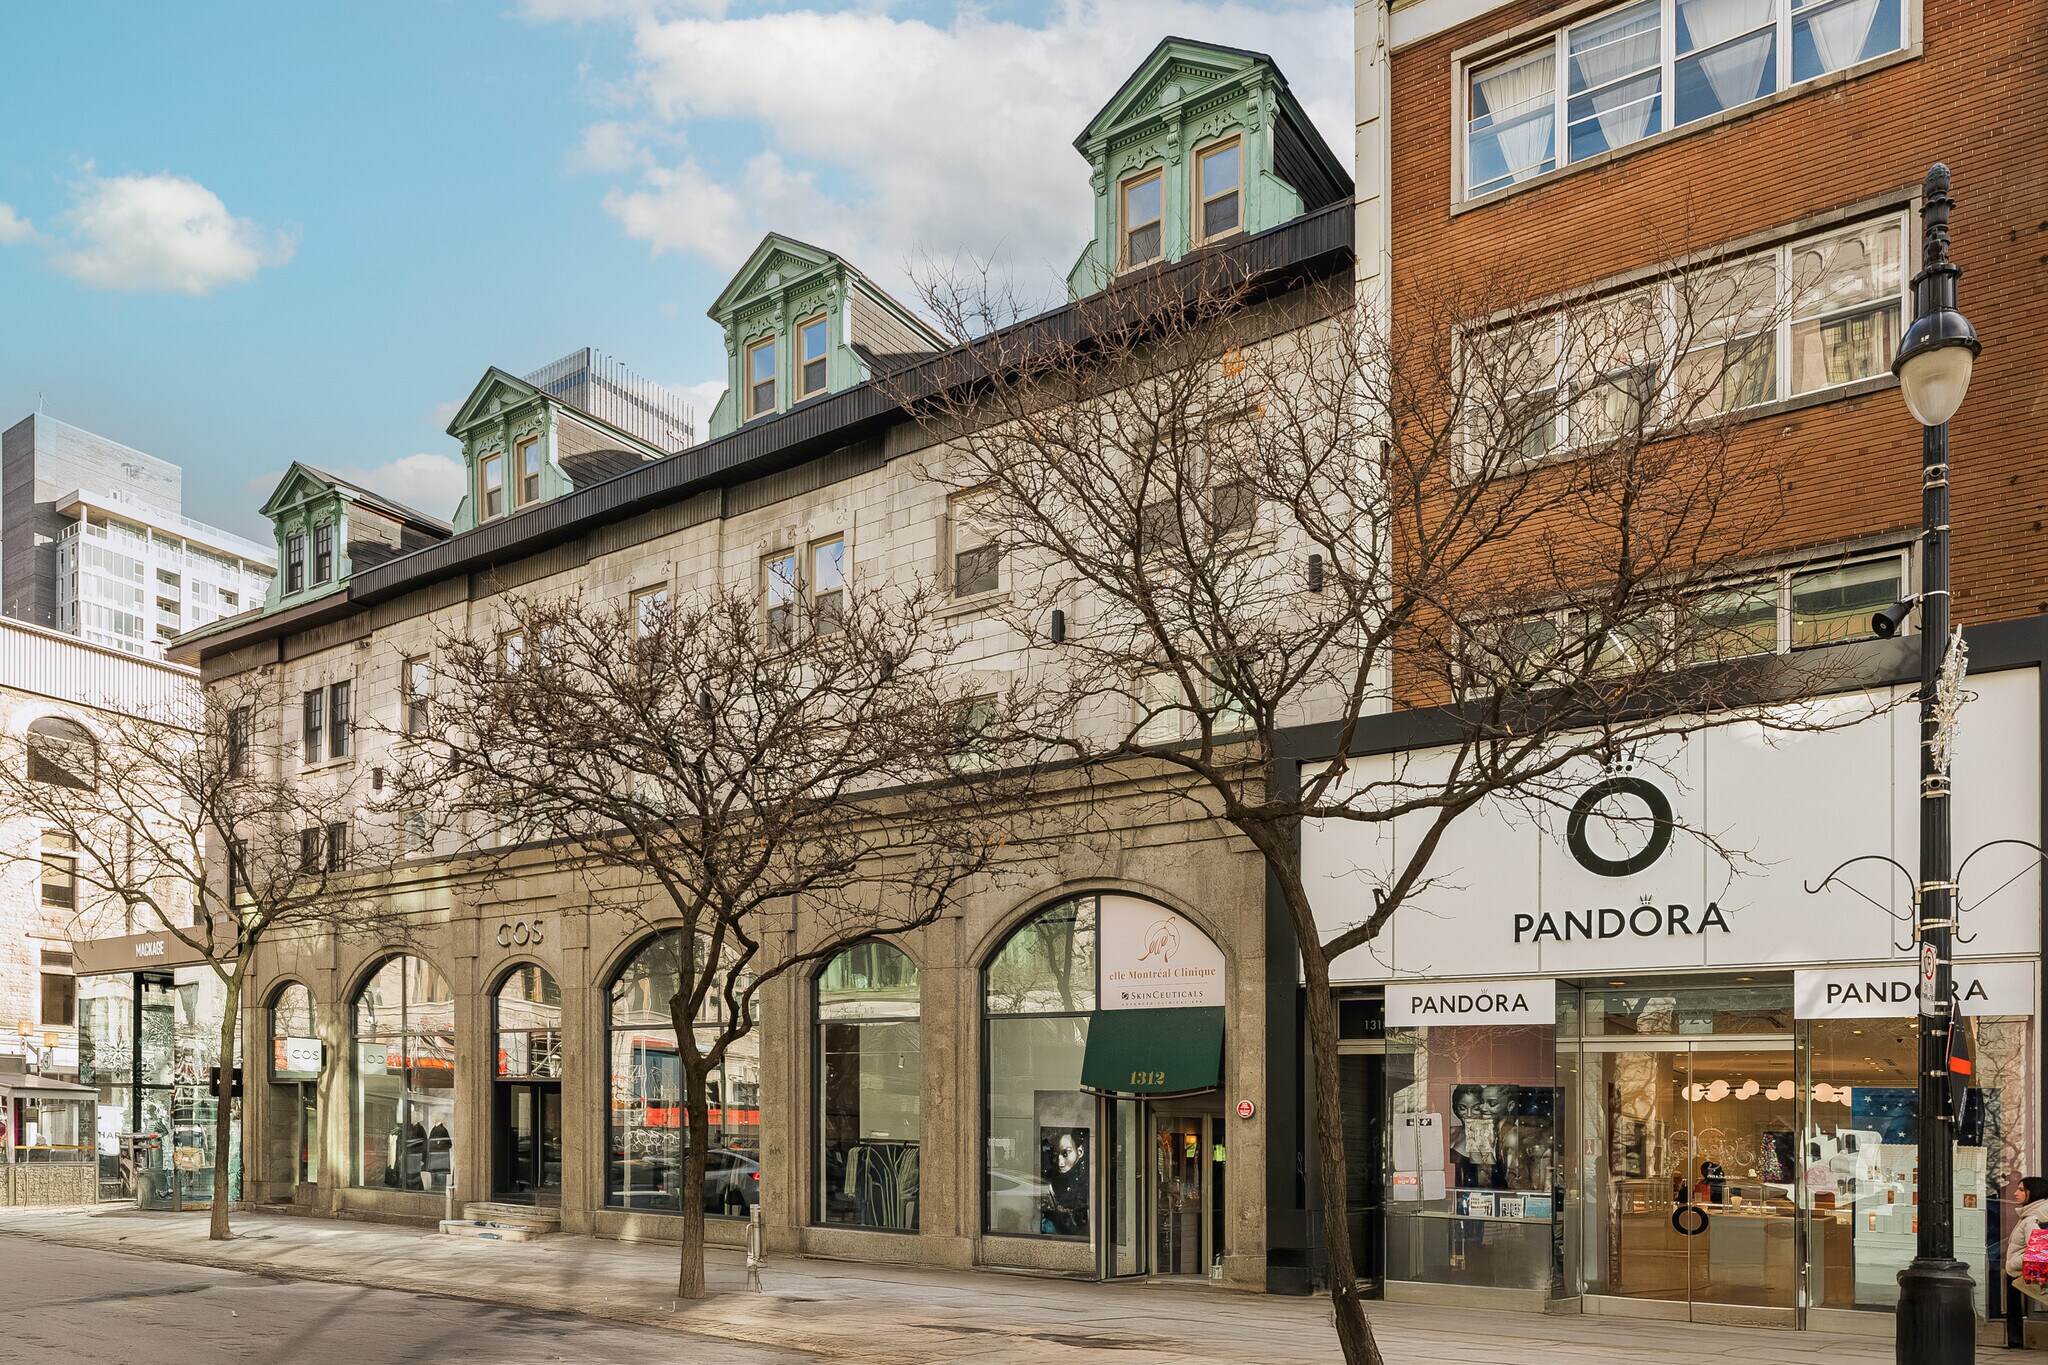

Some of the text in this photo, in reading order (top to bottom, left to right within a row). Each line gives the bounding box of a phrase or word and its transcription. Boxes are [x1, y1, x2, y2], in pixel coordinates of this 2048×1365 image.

[1514, 901, 1731, 943] PANDORA
[497, 920, 543, 947] COS
[135, 940, 164, 957] MACKAGE
[1109, 966, 1216, 981] elle Montréal Clinique
[1827, 980, 1989, 1003] PANDRA
[1412, 994, 1529, 1014] PANDORA
[1365, 1019, 1386, 1031] 131
[292, 1049, 319, 1061] COS
[1130, 1071, 1165, 1085] 1312
